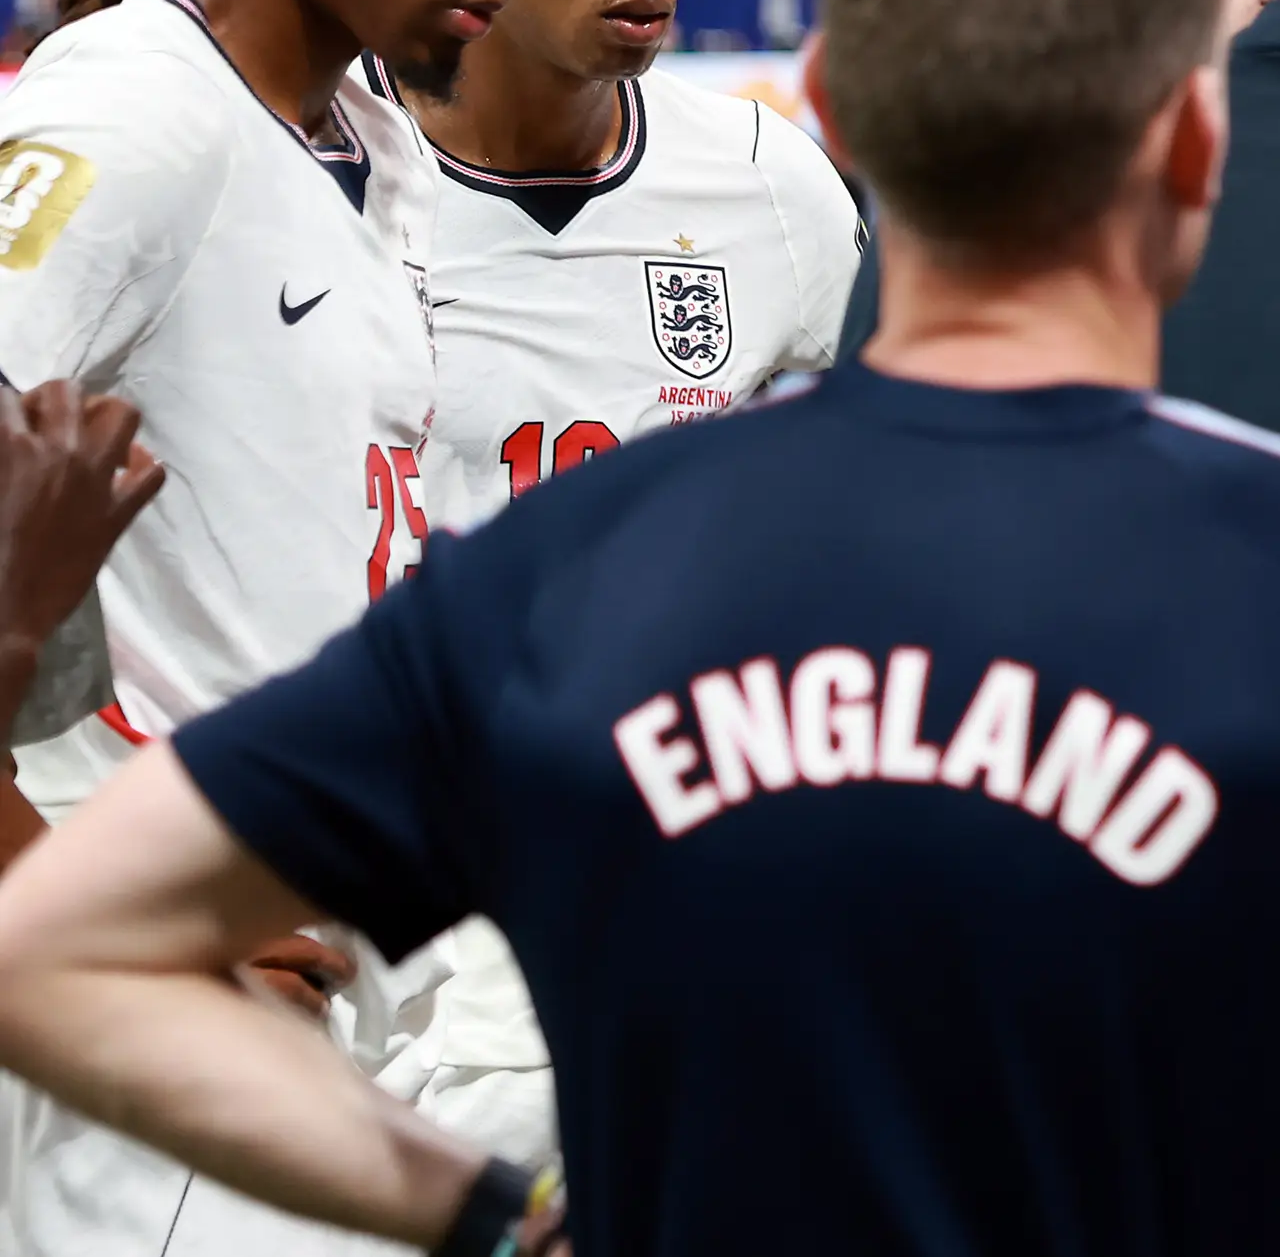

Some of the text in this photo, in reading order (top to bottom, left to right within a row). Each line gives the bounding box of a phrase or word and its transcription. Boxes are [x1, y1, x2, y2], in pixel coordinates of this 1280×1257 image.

[657, 386, 732, 409] ARGENTINA
[365, 443, 428, 608] 25
[613, 643, 1219, 887] ENGLAND
